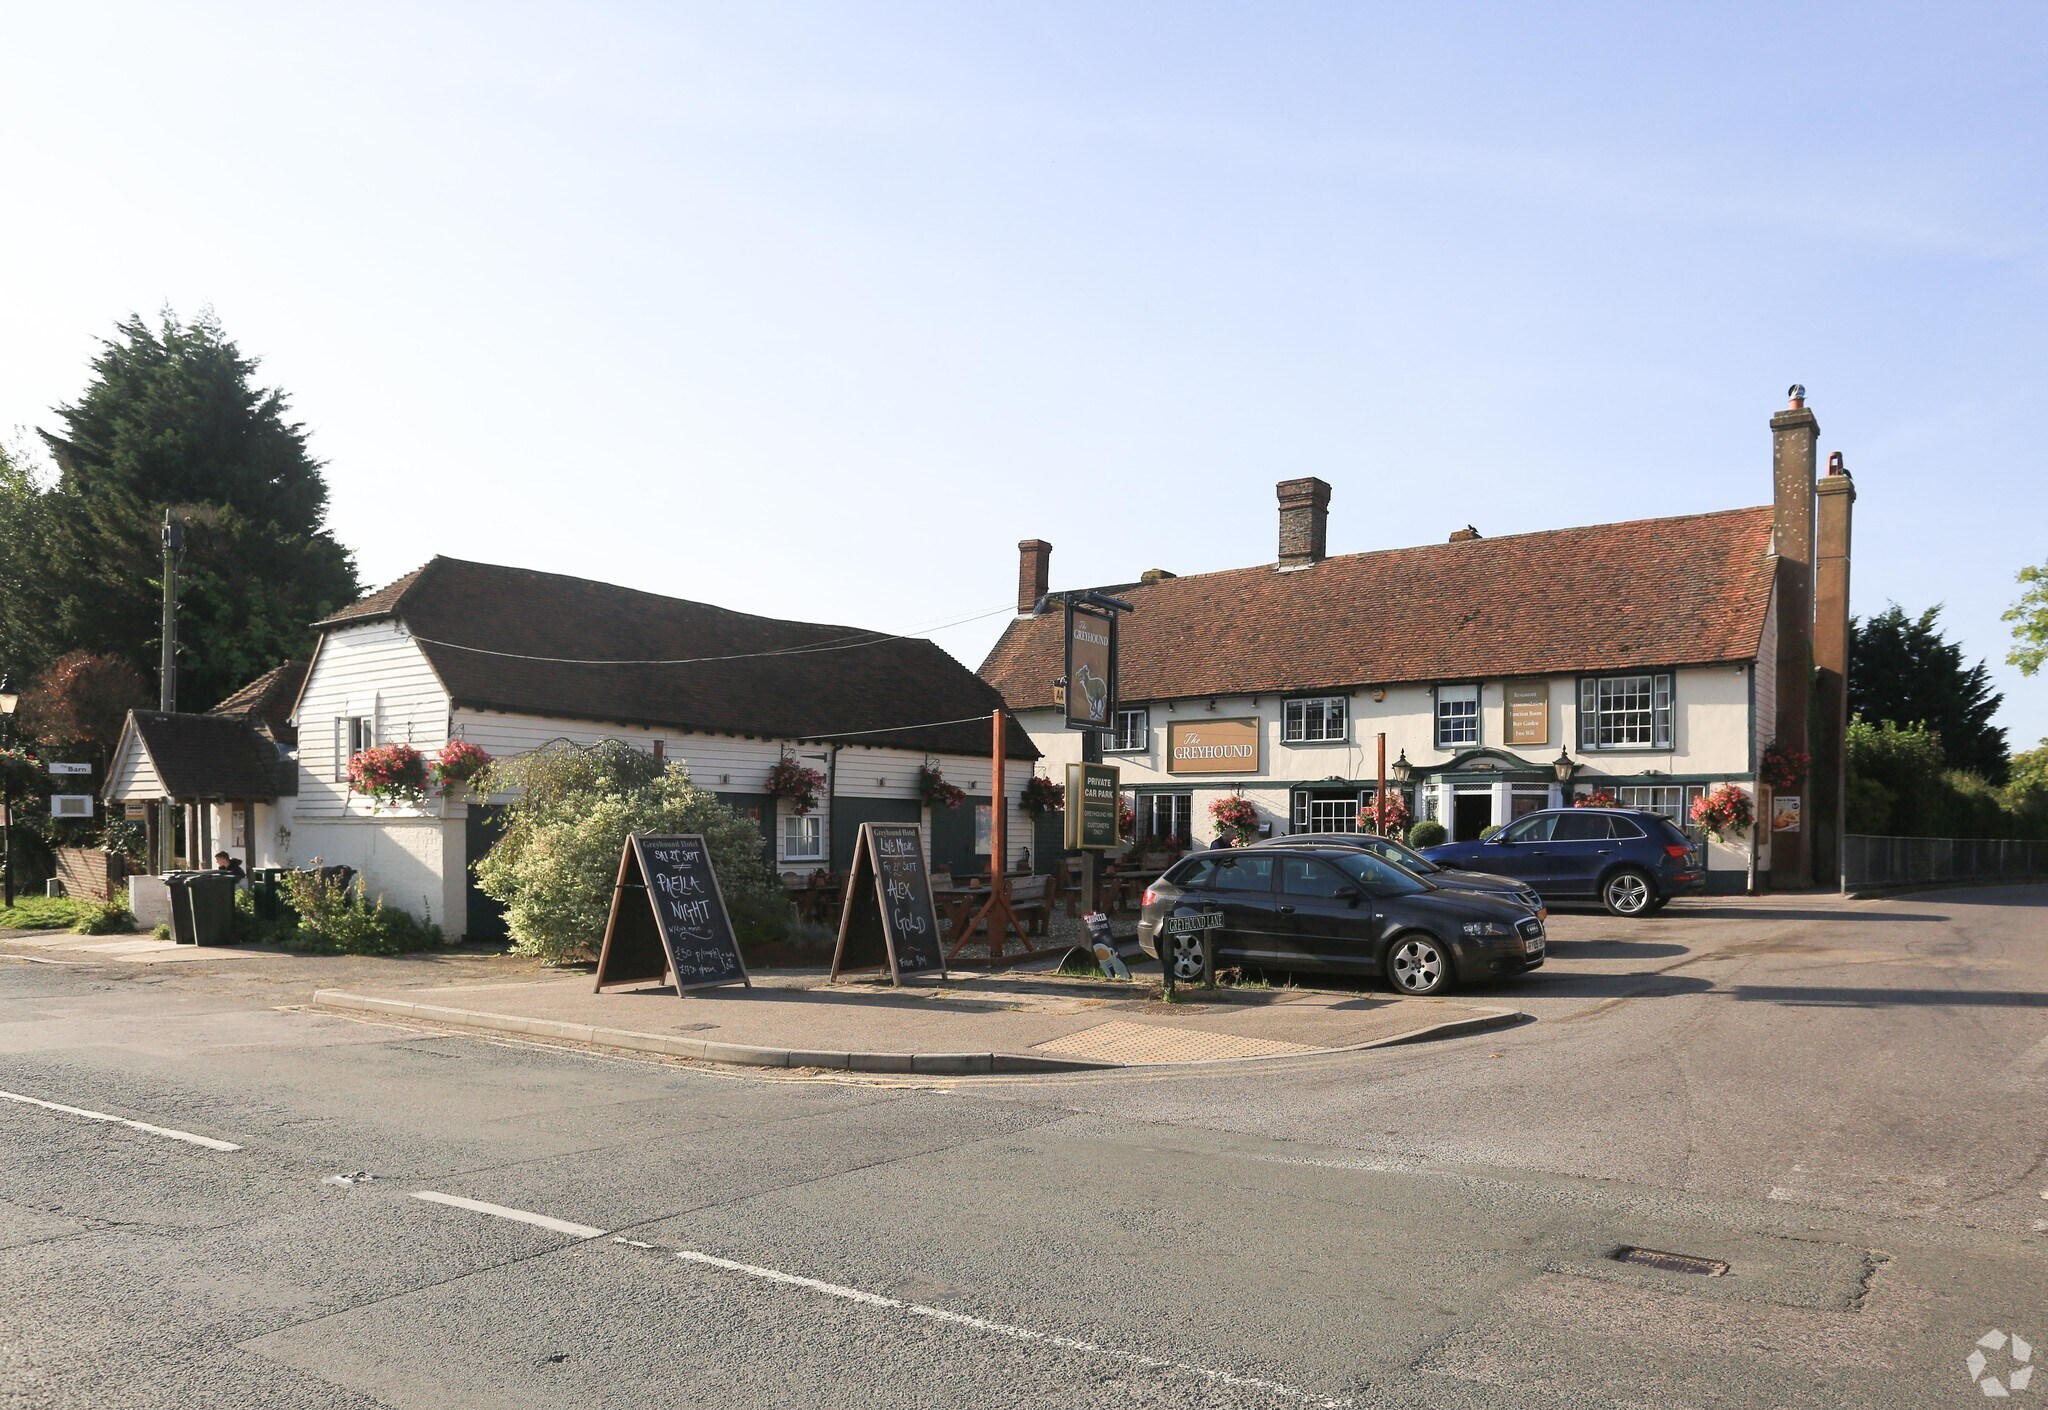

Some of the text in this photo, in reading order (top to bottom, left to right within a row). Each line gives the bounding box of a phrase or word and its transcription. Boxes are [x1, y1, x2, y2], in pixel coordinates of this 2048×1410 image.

[1074, 630, 1109, 646] GREYHOUND
[1056, 689, 1064, 700] AA
[1183, 733, 1200, 744] The
[1173, 744, 1253, 759] GREYHOUND
[1087, 776, 1112, 787] PRIVATE
[1084, 788, 1114, 799] CAR PARK
[874, 829, 901, 837] Greyhound
[643, 840, 699, 849] Greyhound Hotel
[656, 873, 705, 899] PAELLA
[887, 878, 915, 905] ALEX
[670, 899, 710, 926] NIGHT
[895, 908, 926, 940] GOLD
[1169, 914, 1223, 932] GREYHOUND LANE
